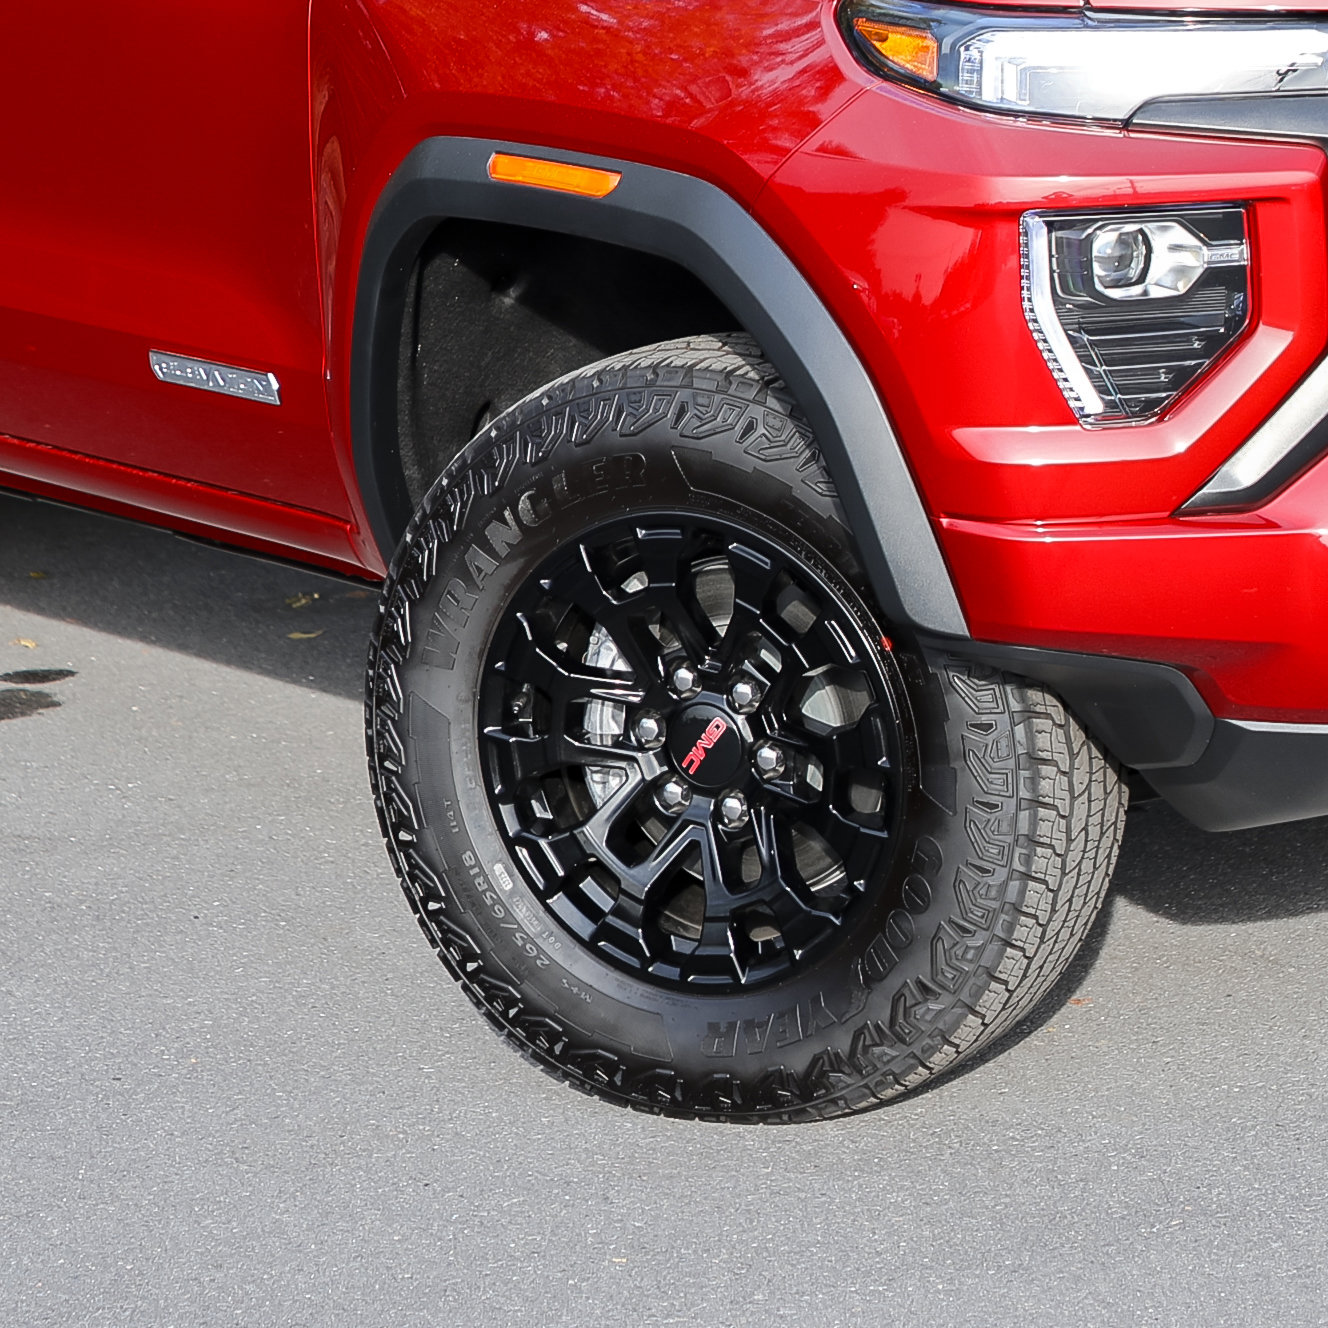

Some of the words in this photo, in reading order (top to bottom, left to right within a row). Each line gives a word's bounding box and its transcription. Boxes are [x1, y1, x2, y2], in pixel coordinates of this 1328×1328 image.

[421, 452, 648, 671] WRANGLER
[681, 716, 727, 775] GMC
[444, 798, 460, 833] 114T
[461, 850, 552, 969] 265/65R18
